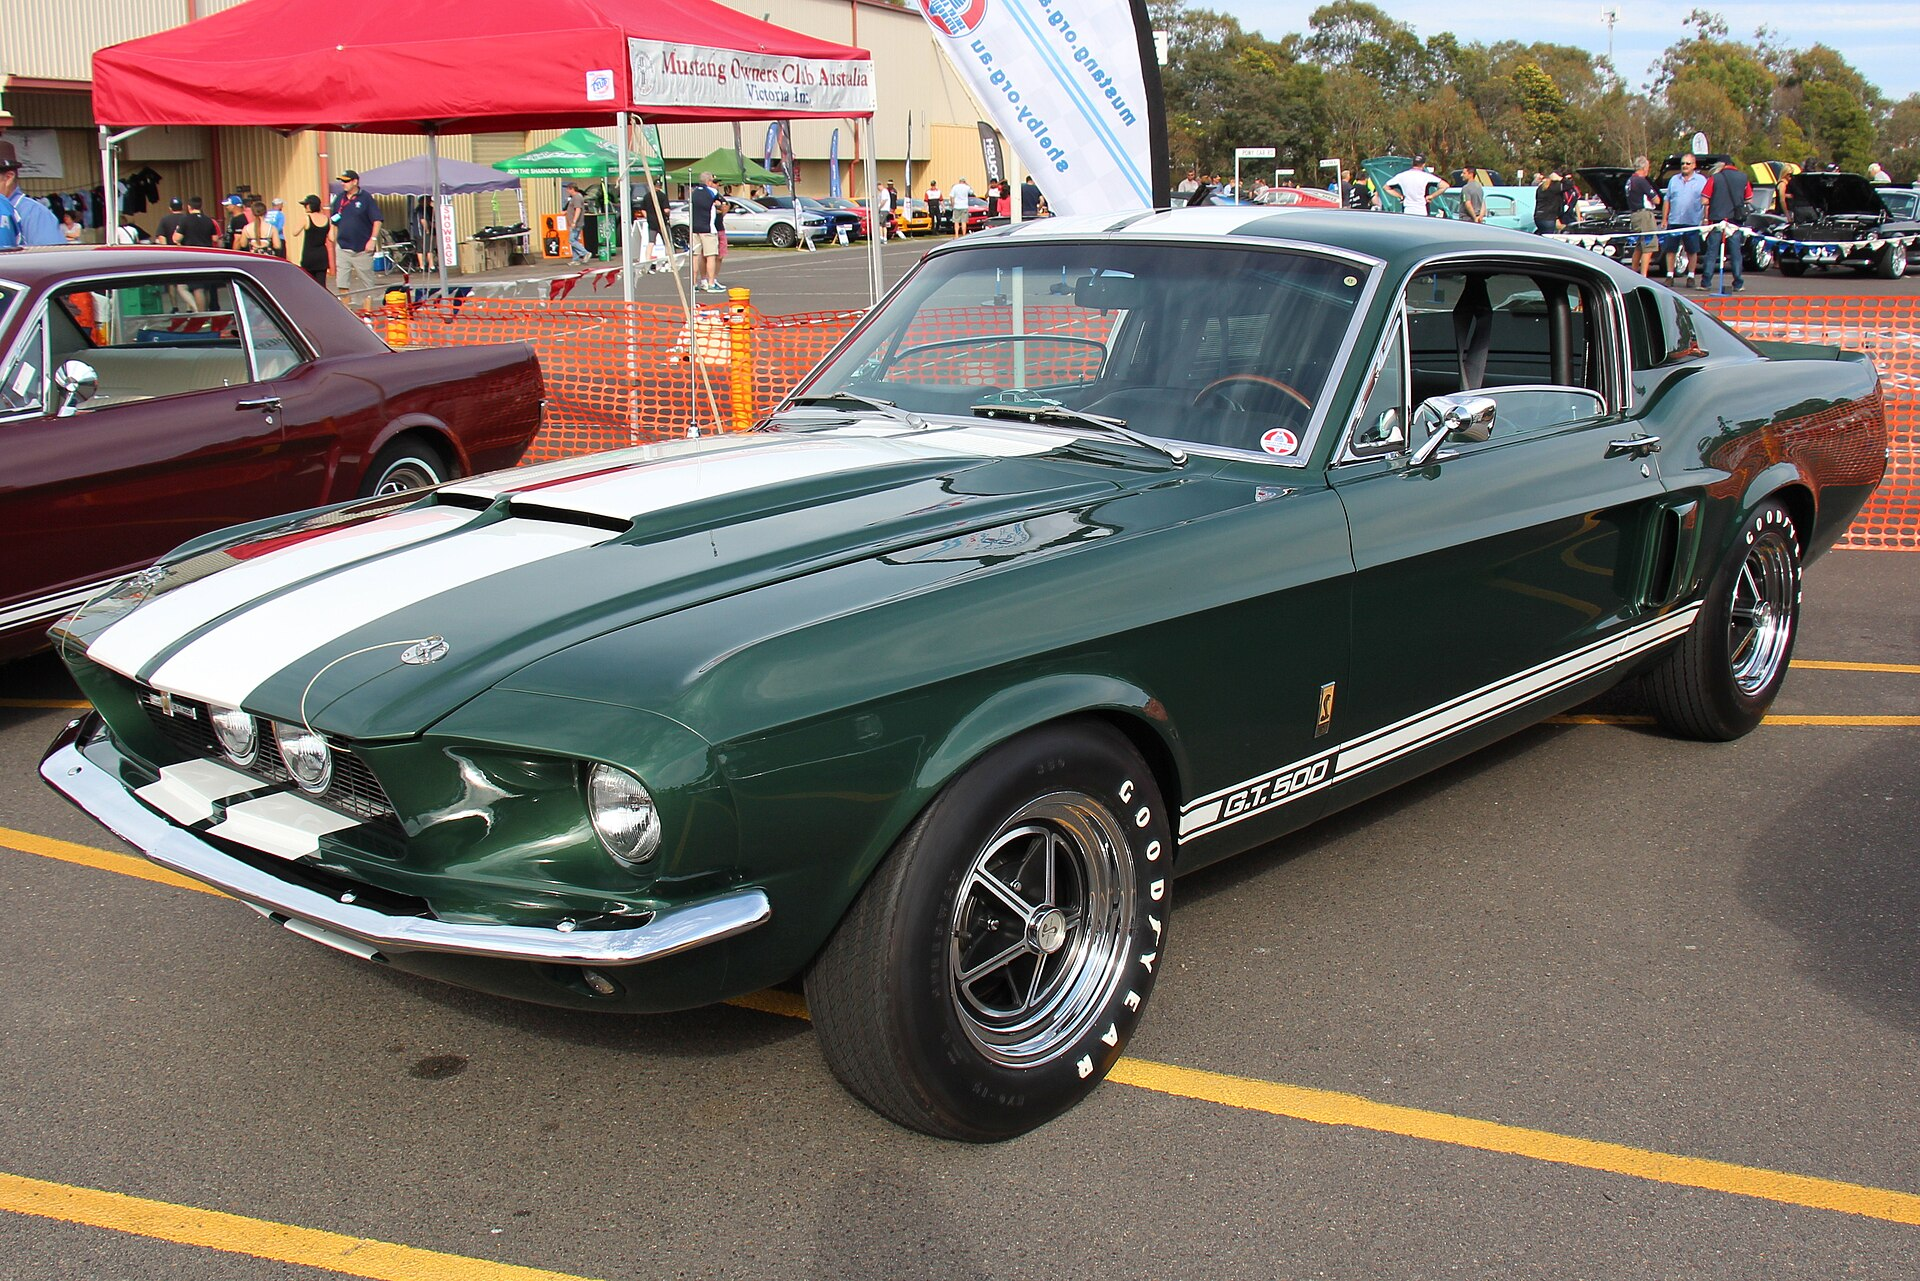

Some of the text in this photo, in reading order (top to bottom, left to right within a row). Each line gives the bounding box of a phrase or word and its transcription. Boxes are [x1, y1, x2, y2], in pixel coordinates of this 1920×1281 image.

[662, 51, 727, 85] Mustang
[731, 58, 779, 83] Owners
[819, 67, 868, 87] Austalia
[746, 83, 790, 102] Victoria
[443, 206, 453, 265] SHOWBAGS
[1076, 779, 1164, 1079] GOODYEAR
